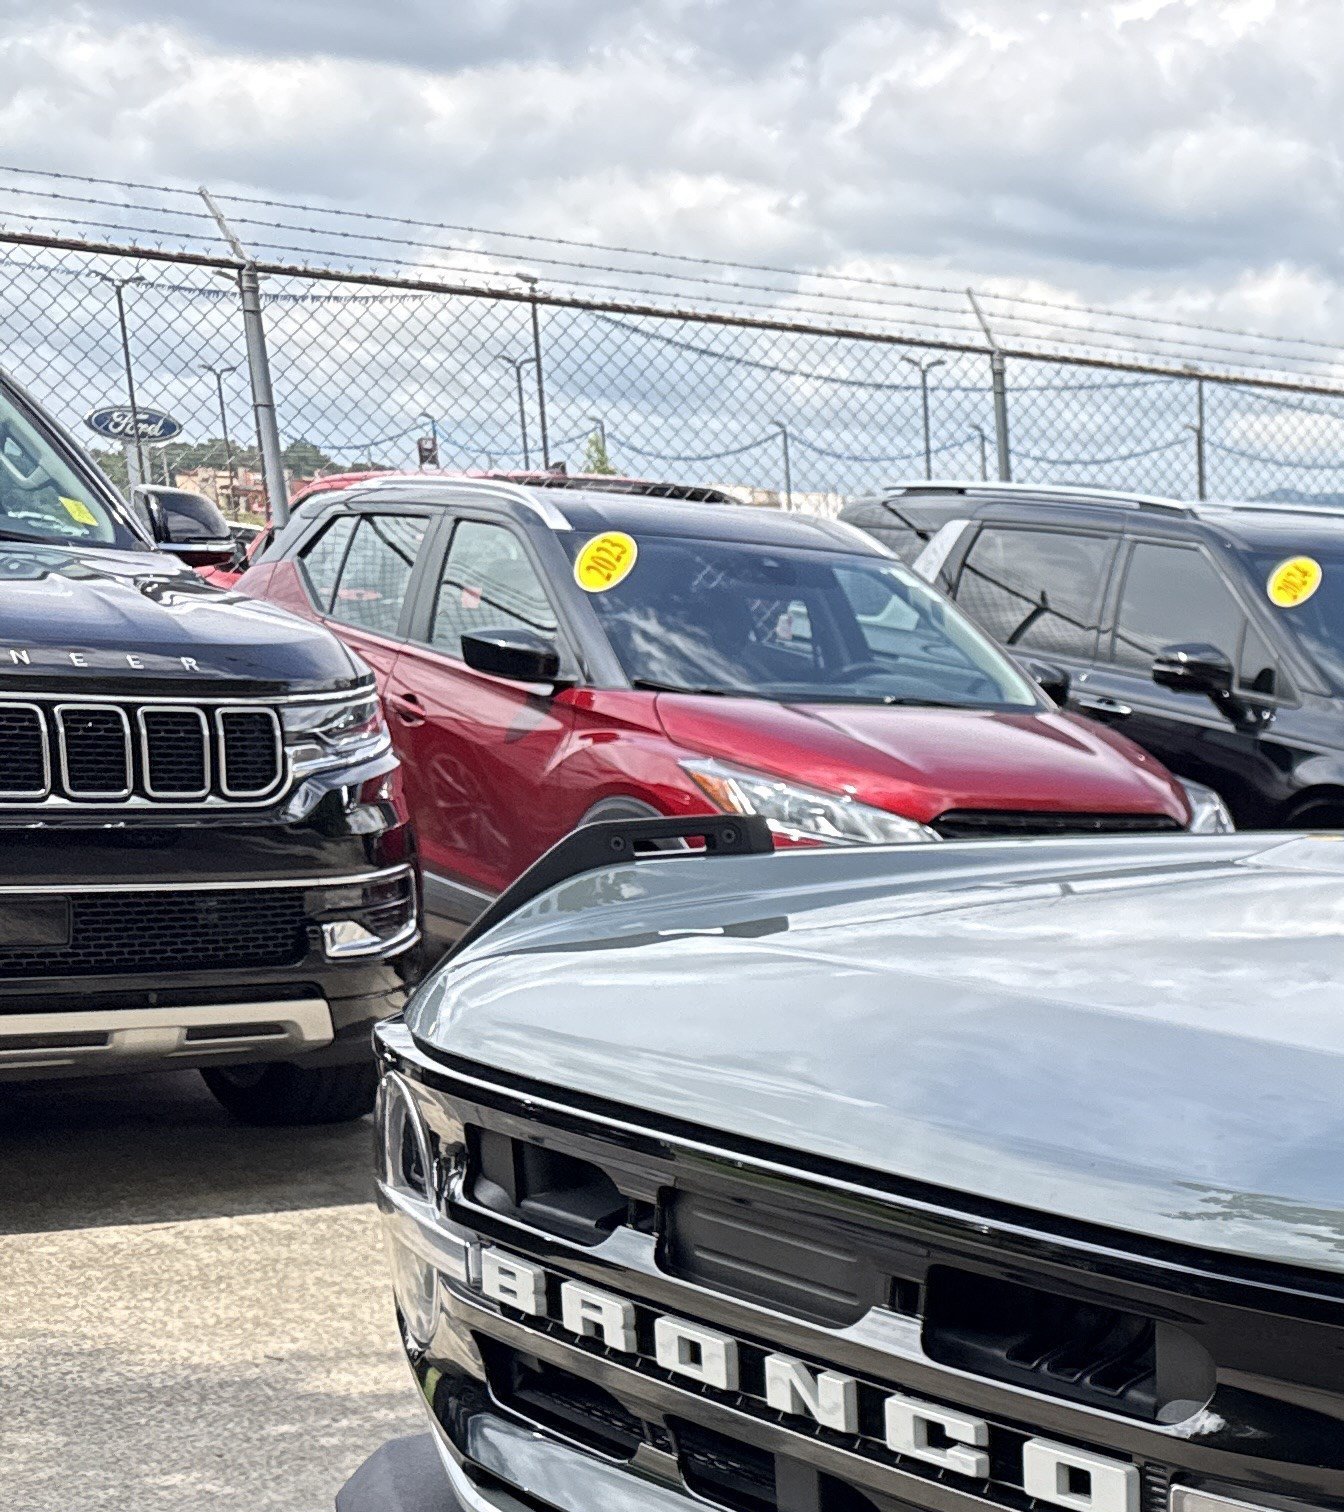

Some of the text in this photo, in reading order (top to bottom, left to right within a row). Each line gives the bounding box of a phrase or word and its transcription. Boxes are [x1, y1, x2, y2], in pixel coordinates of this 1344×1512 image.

[108, 411, 165, 437] Ford
[586, 539, 627, 582] 2023
[9, 649, 200, 672] NEER
